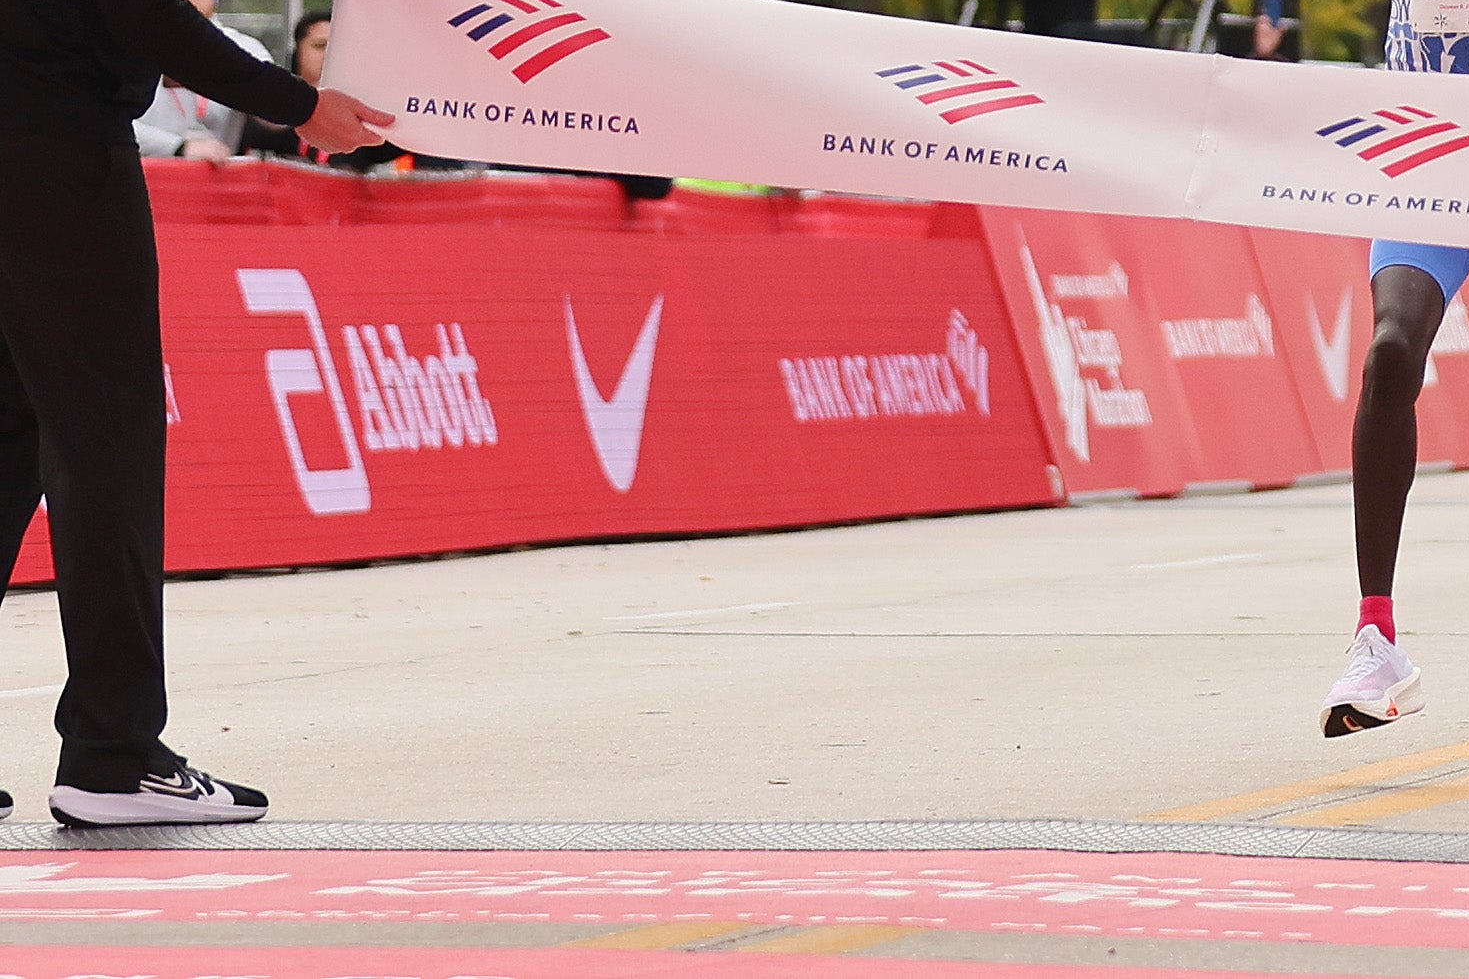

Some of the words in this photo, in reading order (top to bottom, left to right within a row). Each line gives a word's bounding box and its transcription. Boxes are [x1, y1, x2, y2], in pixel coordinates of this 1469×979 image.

[405, 96, 477, 120] BANK
[484, 104, 516, 123] OF
[521, 108, 640, 135] AMERICA
[822, 133, 896, 157] BANK
[904, 141, 939, 160] OF
[943, 145, 1068, 173] AMERICA
[1262, 185, 1336, 204] BANK
[1345, 192, 1380, 207] OF
[341, 322, 499, 451] Abbott
[780, 357, 853, 421] BANK
[840, 354, 878, 418] OF
[869, 352, 966, 417] AMERICA
